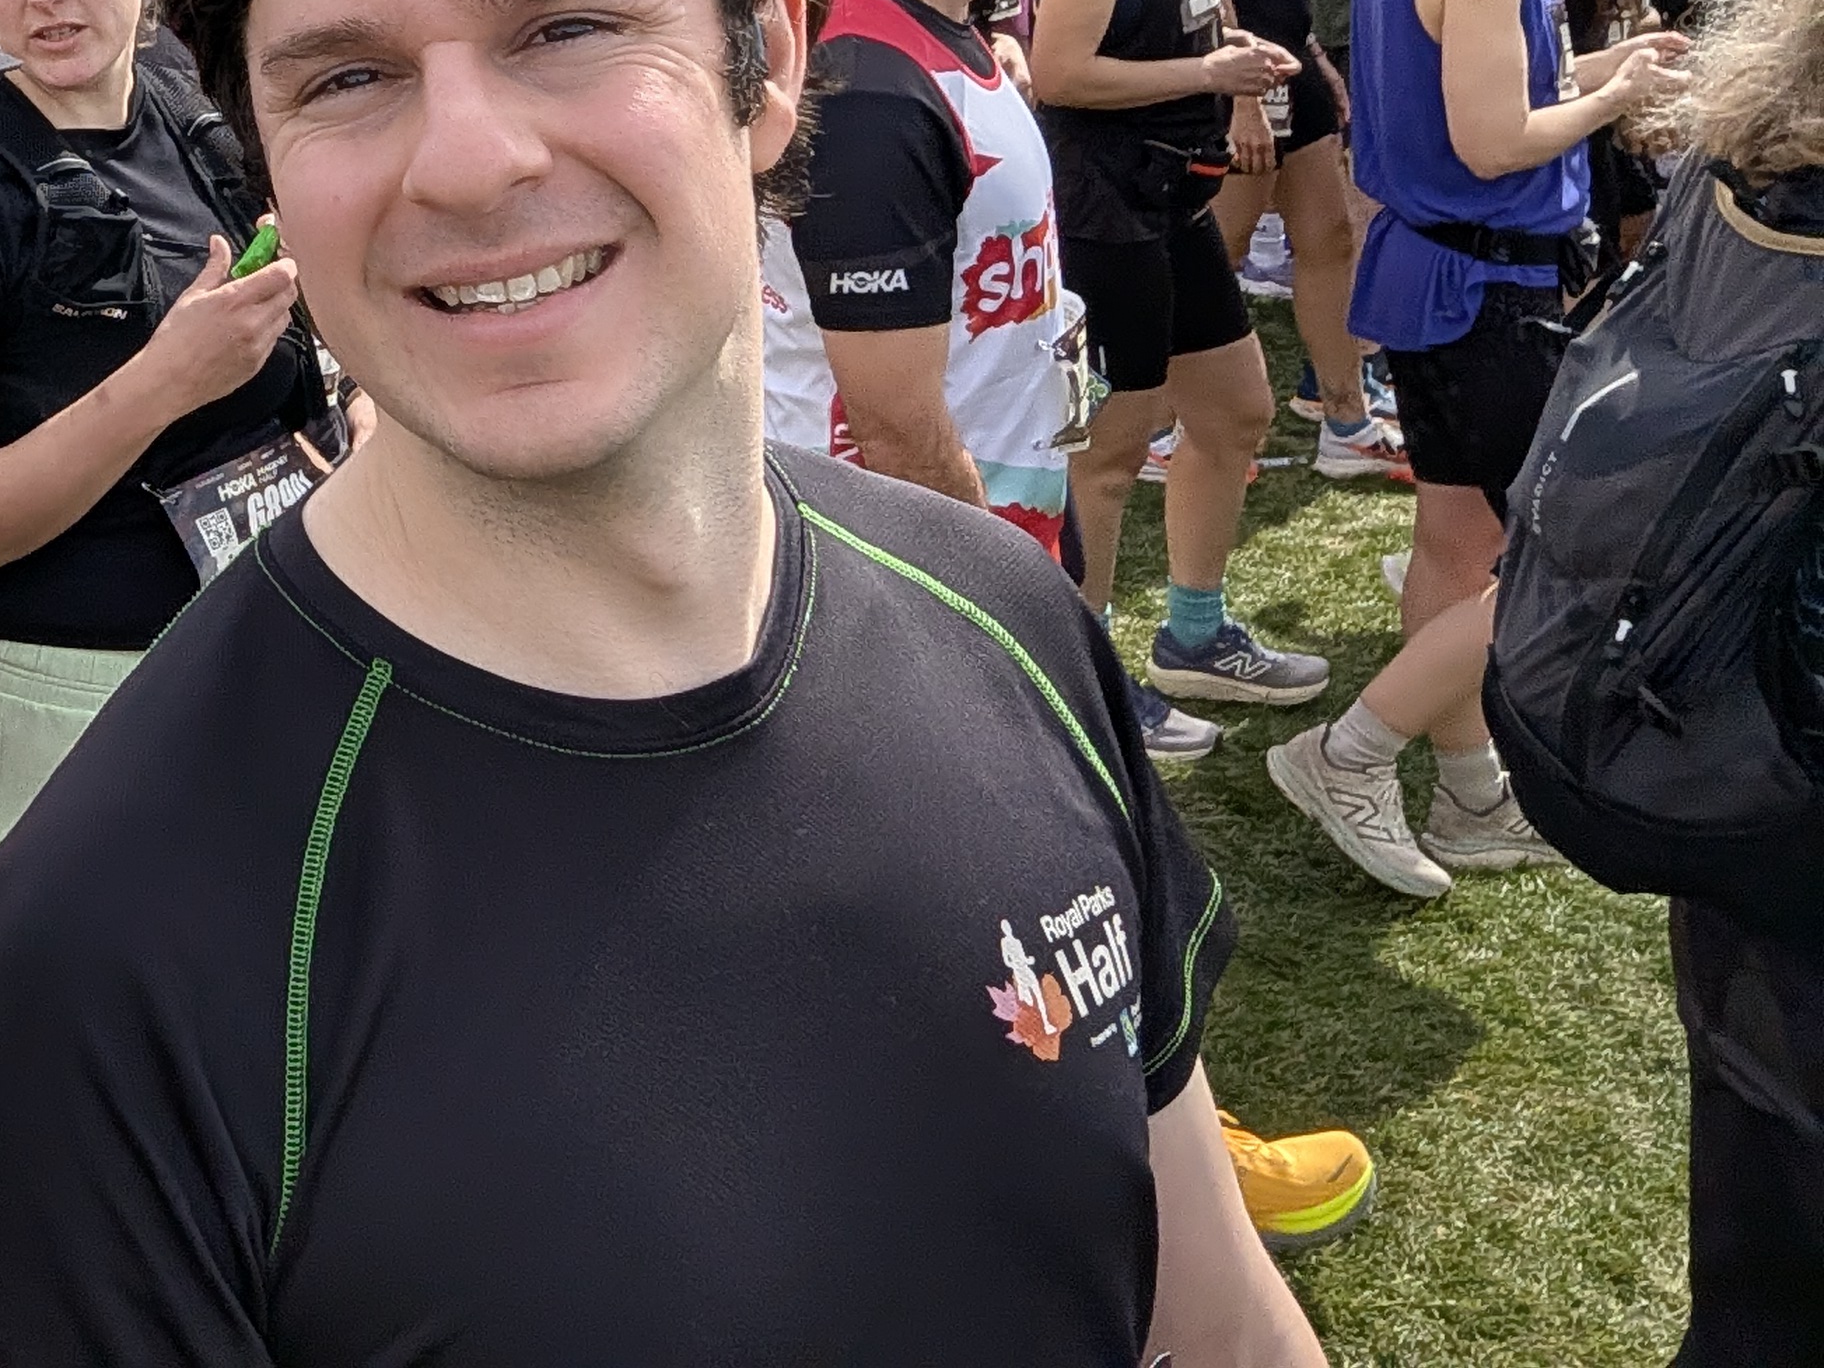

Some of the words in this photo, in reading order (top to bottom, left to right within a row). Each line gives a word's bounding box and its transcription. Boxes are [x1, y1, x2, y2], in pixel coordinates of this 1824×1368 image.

[829, 268, 910, 294] HOKA
[217, 472, 258, 502] HOKA
[1039, 895, 1081, 943] Royal
[1077, 885, 1115, 921] Parks
[1054, 912, 1133, 1019] Half
